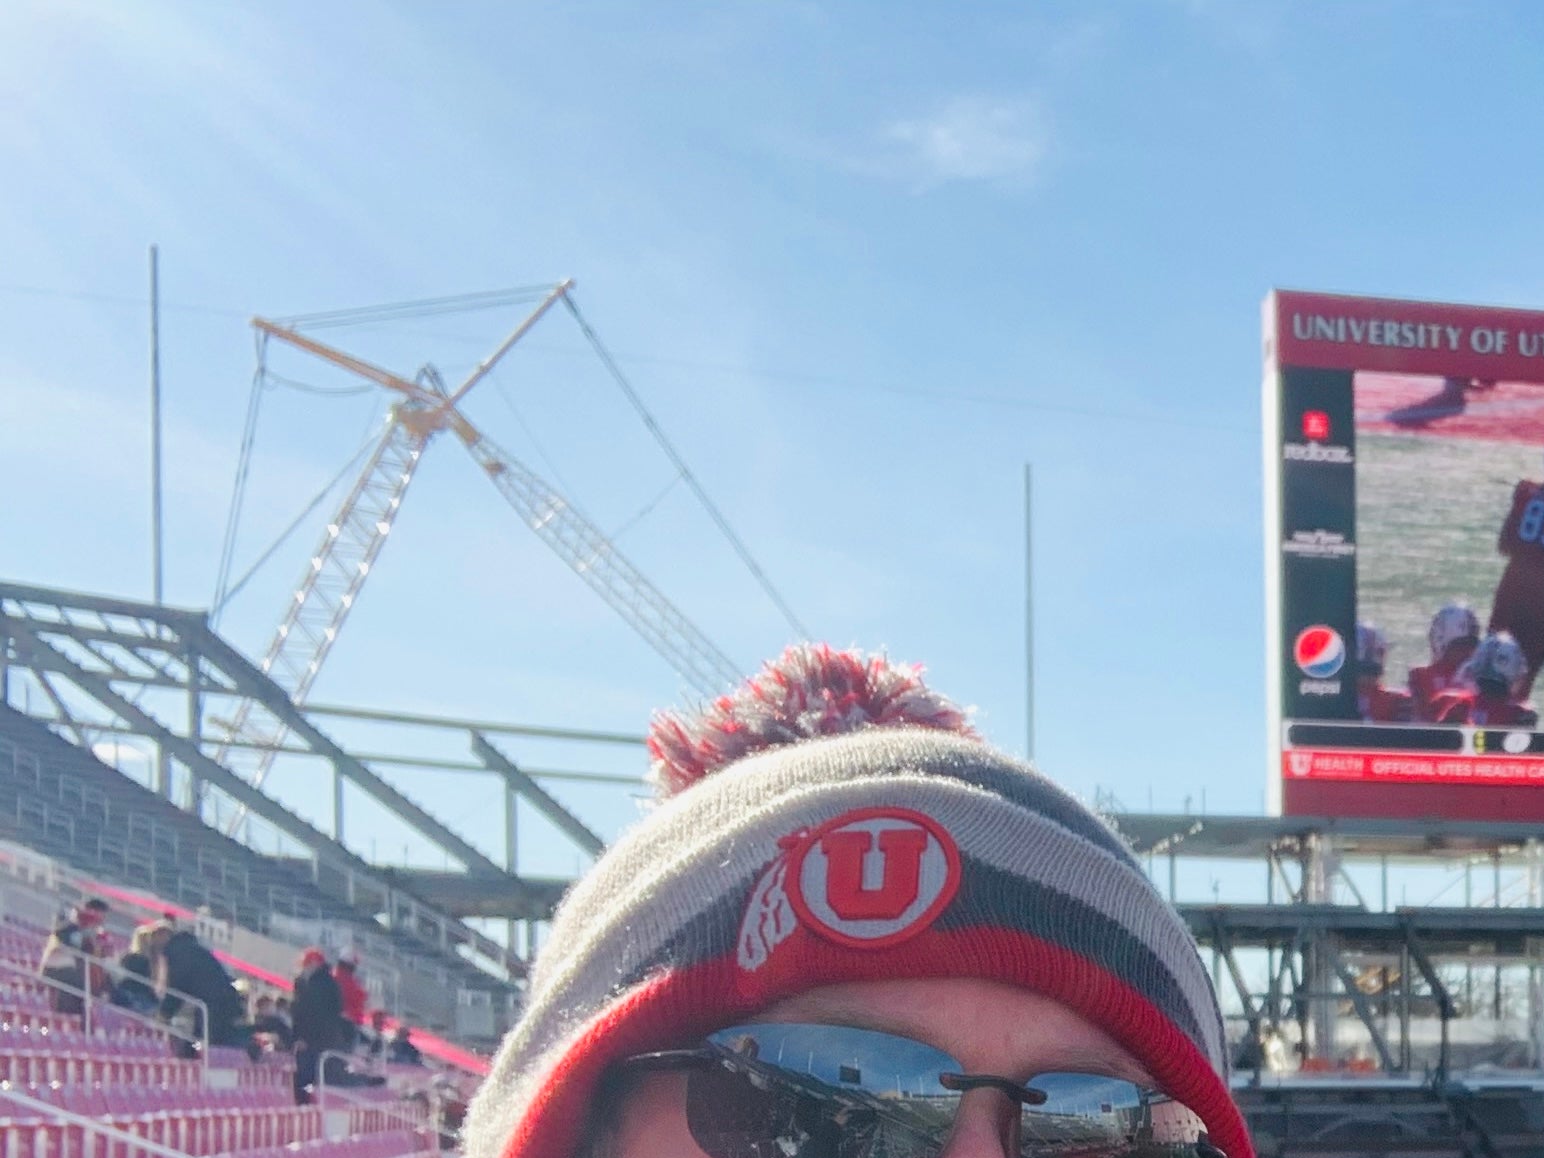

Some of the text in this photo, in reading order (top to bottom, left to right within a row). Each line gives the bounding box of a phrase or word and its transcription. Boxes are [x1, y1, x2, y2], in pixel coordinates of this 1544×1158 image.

[1292, 313, 1461, 351] UNIVERSITY
[1470, 328, 1507, 355] OF
[1315, 757, 1363, 771] HEALTH
[1371, 759, 1434, 776] OFFICIAL
[1437, 763, 1472, 777] UTES
[1475, 764, 1525, 779] HEALTH
[822, 829, 928, 921] U
